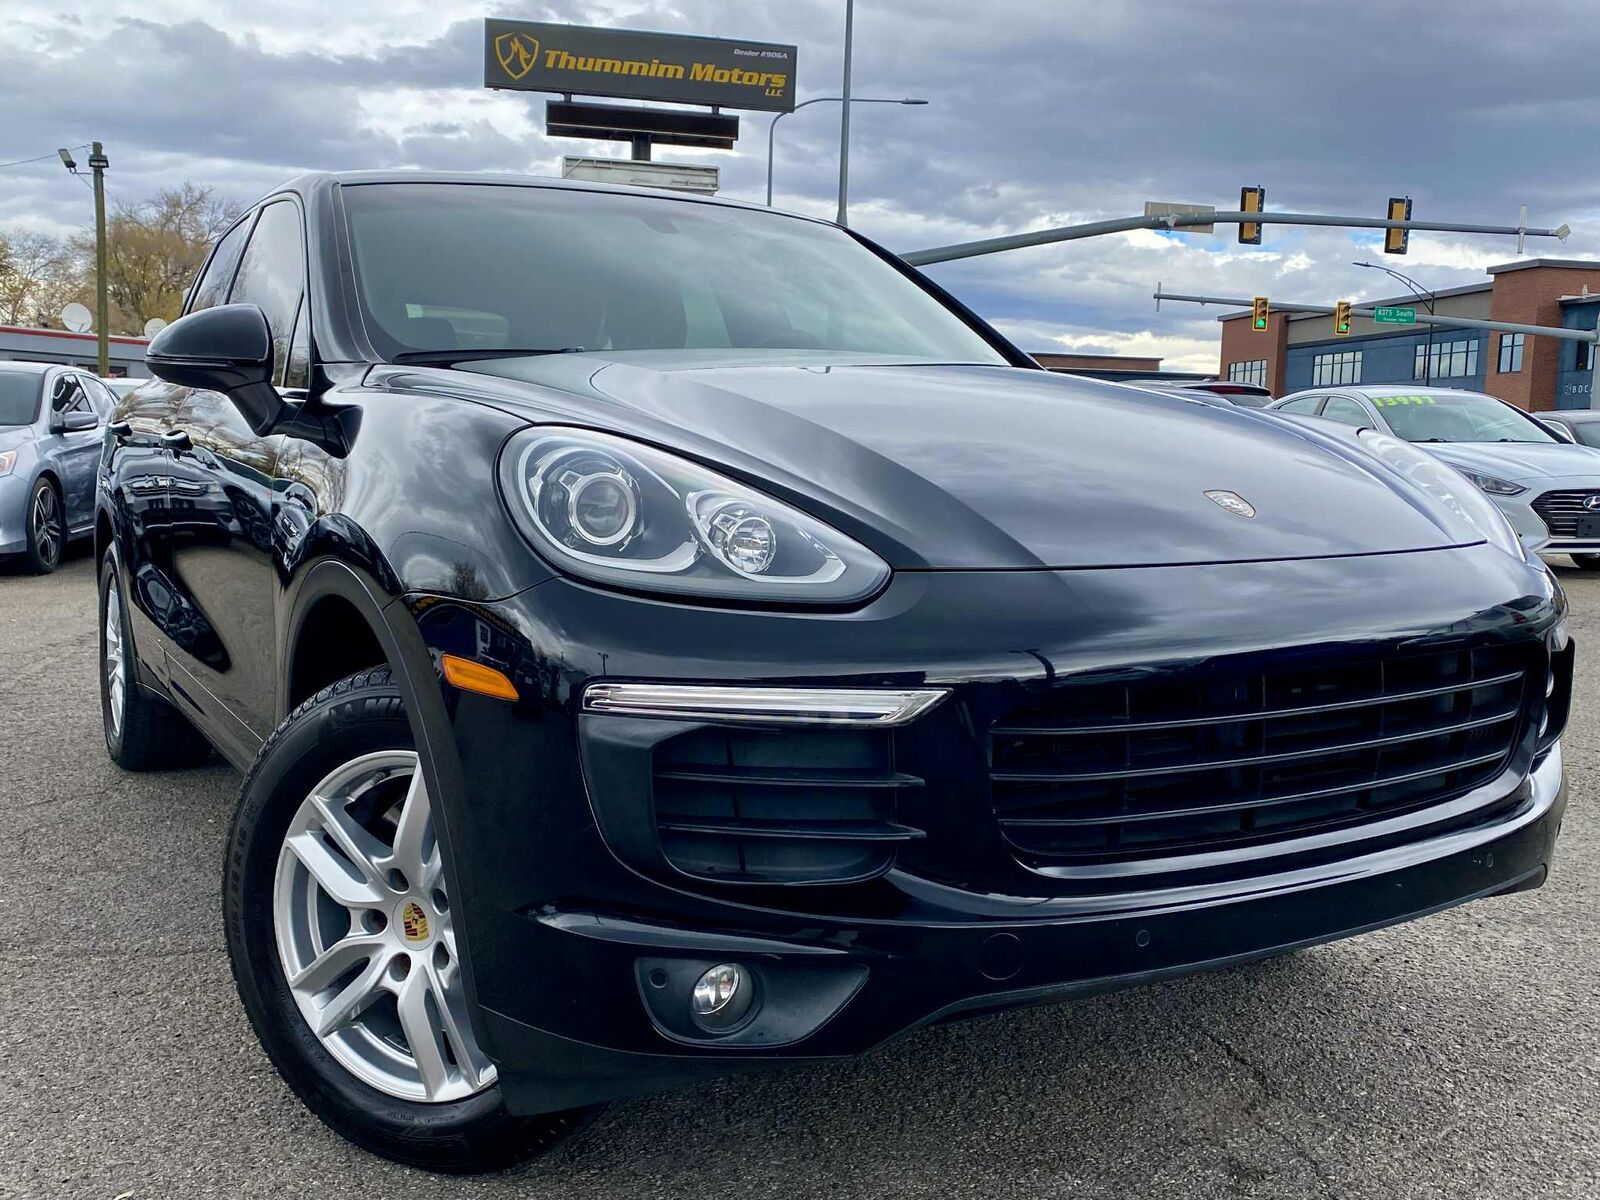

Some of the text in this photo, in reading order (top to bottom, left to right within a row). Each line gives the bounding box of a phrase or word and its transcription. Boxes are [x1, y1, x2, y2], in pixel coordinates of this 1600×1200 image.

[733, 48, 760, 57] Dealer
[545, 49, 787, 88] Thummim Motors
[764, 88, 784, 97] LLC
[1395, 309, 1414, 318] South
